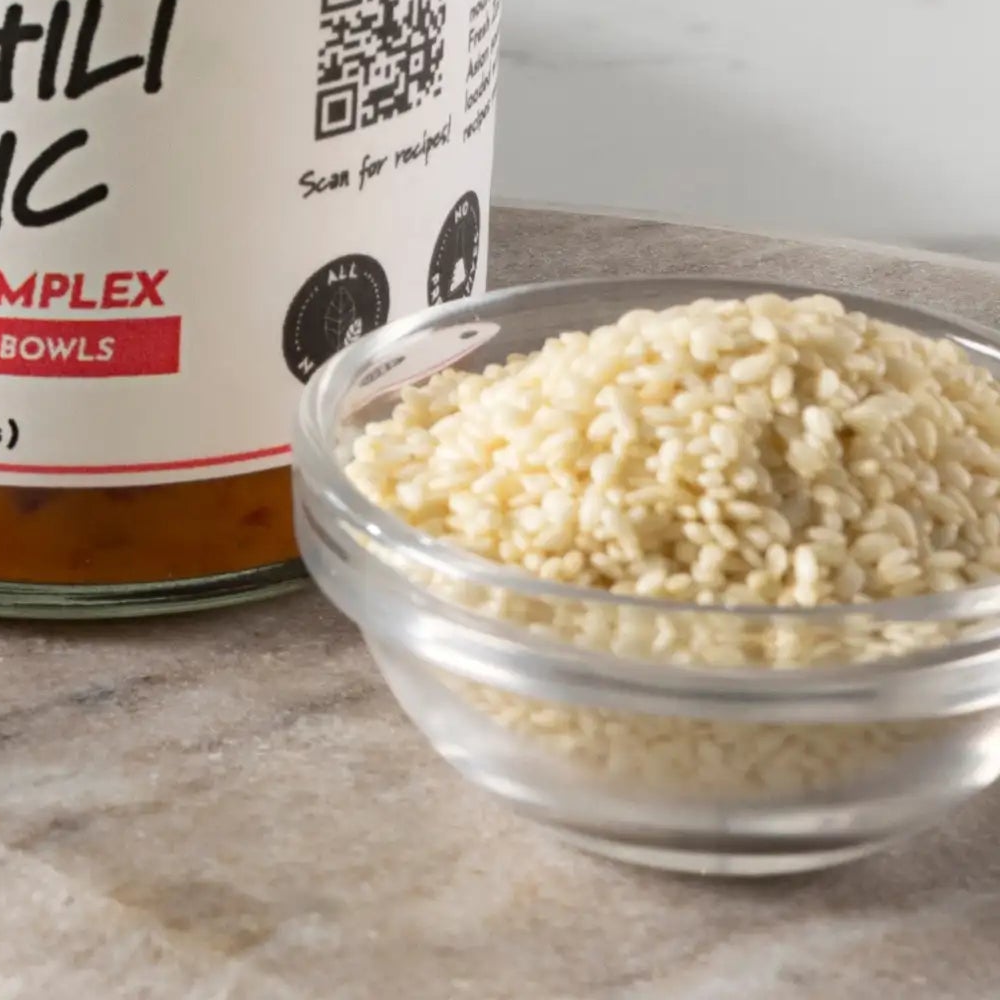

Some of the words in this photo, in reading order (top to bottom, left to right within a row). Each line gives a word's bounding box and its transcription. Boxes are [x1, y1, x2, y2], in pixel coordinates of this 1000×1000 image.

[298, 169, 350, 199] Scan
[358, 154, 388, 191] for
[394, 113, 452, 169] recipes!
[327, 261, 359, 286] ALL
[0, 333, 115, 361] BOWLS
